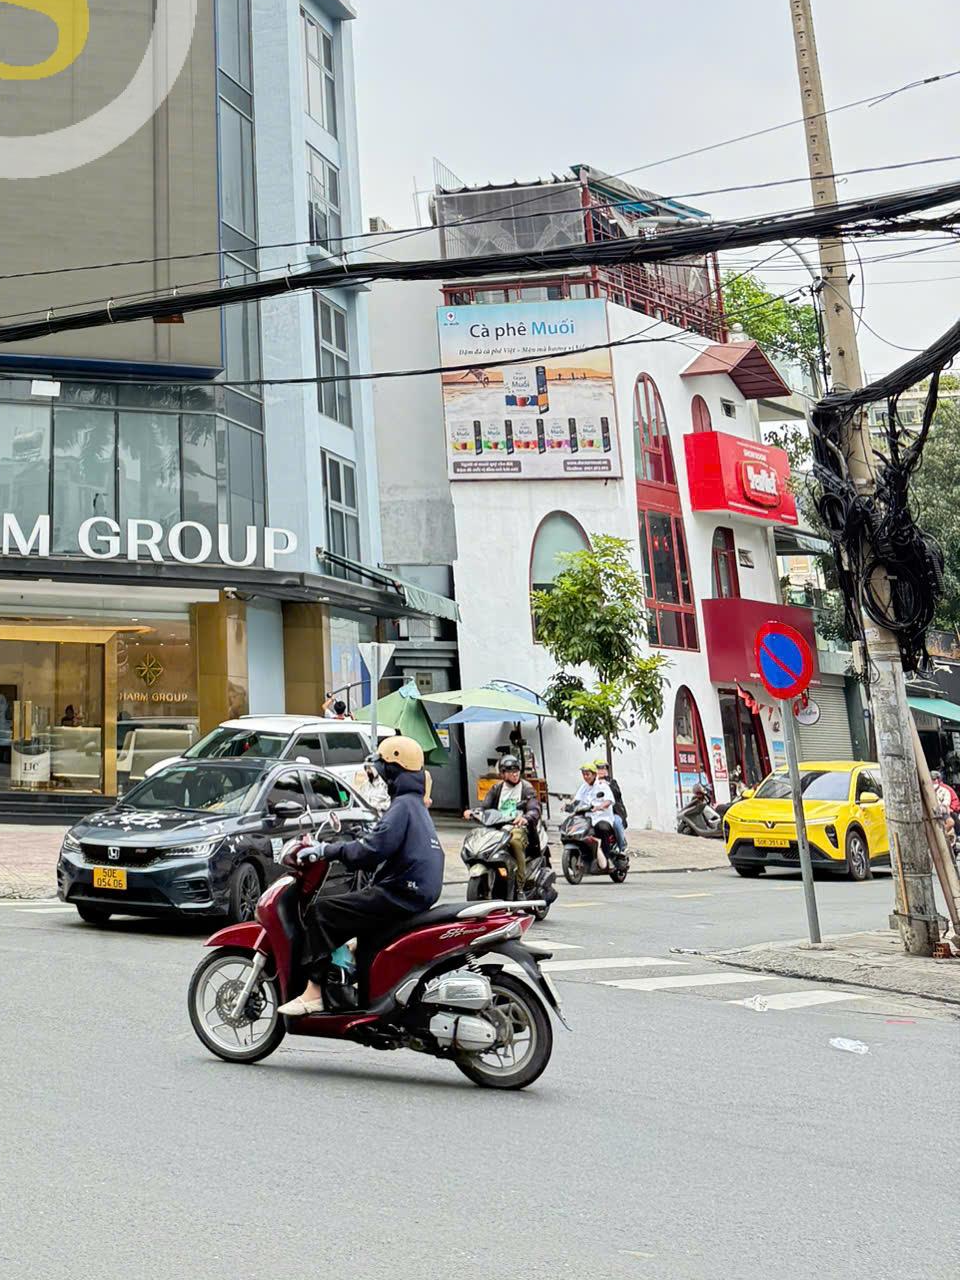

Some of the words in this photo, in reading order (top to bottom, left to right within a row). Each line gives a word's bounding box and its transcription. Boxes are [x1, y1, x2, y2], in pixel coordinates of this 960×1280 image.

[470, 323, 490, 337] Cà
[495, 321, 527, 340] phê
[531, 318, 575, 335] Muối
[77, 516, 298, 569] GROUP
[119, 691, 148, 703] HARM
[151, 691, 189, 703] GROUP
[102, 868, 118, 878] 50E
